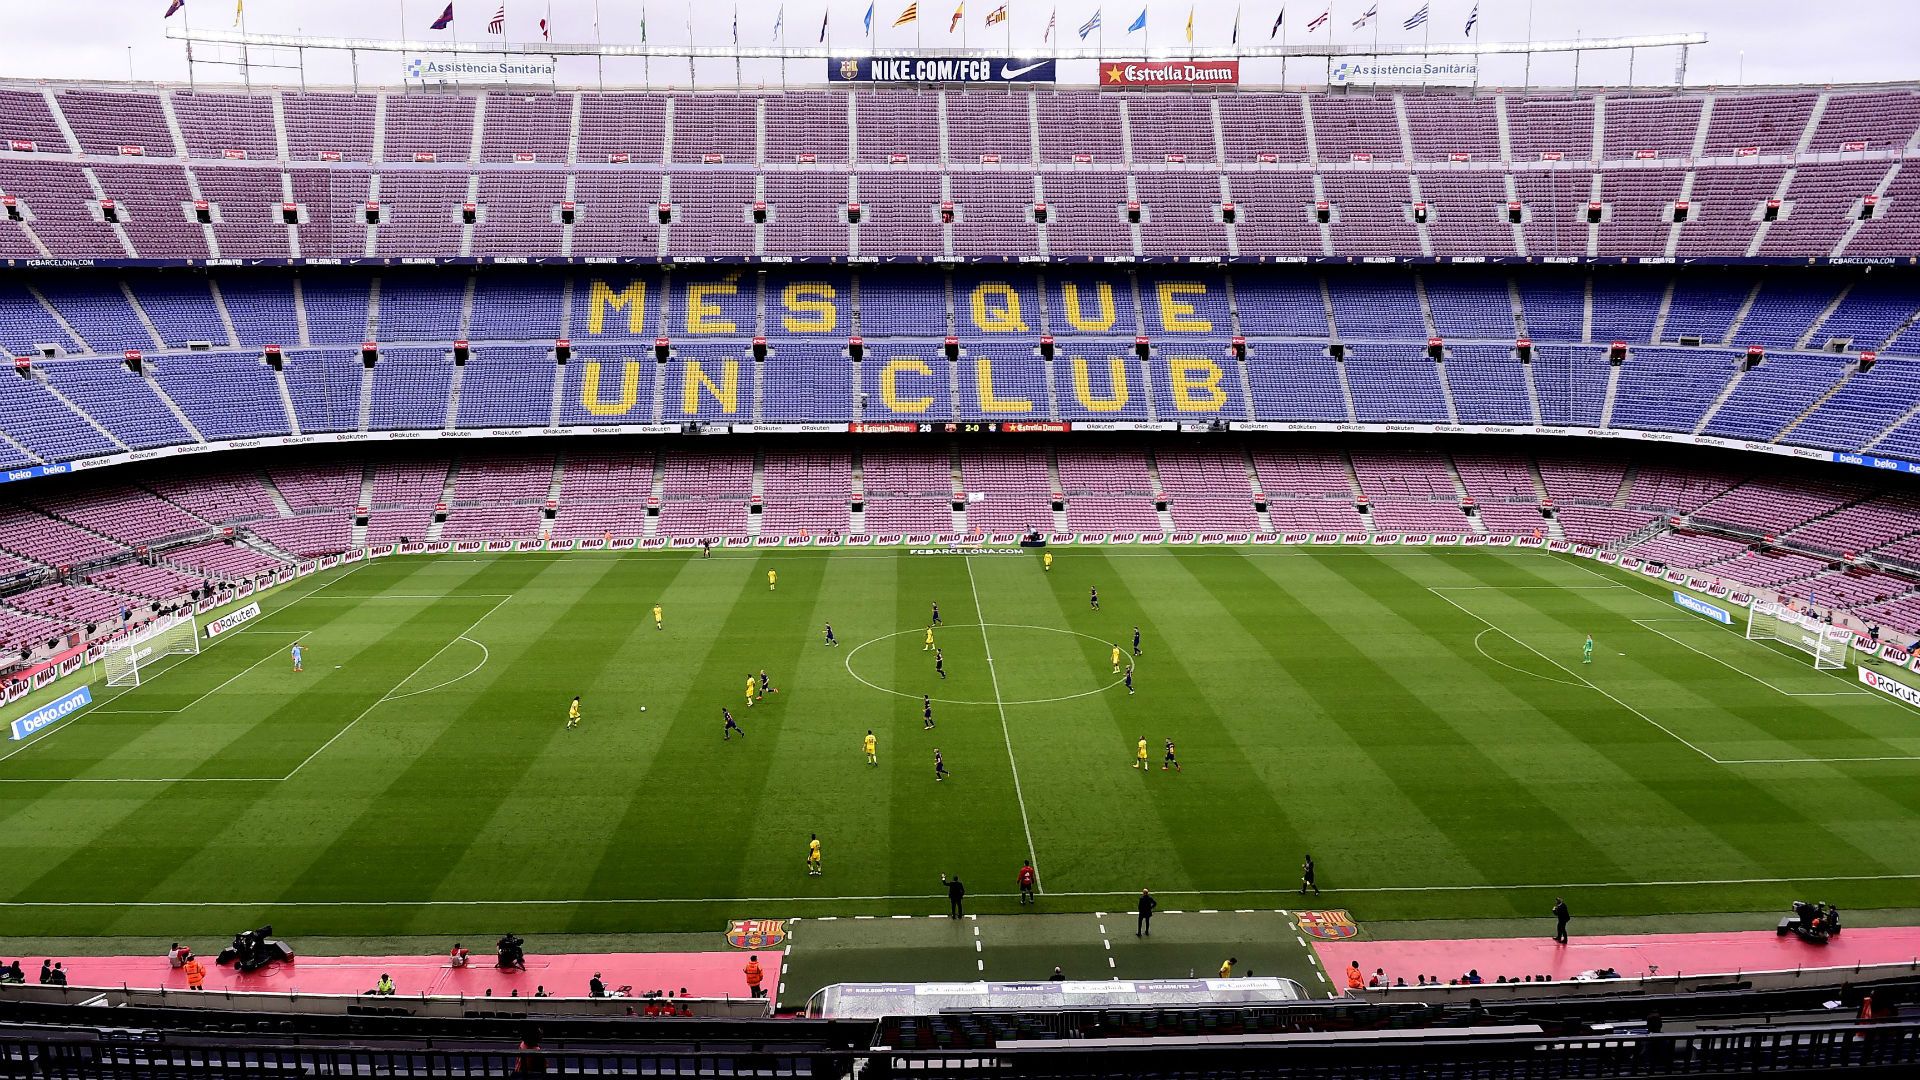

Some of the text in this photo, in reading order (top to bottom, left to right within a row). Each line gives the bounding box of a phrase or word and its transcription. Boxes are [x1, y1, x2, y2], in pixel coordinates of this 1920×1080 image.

[428, 60, 552, 74] Assistència Sanitària
[871, 60, 991, 81] NIKE.COM/FCB
[1353, 62, 1477, 76] Assistència Sanitària
[1124, 64, 1232, 82] Estrella Damm
[26, 259, 95, 267] FCBARCELONA.COM
[1829, 257, 1895, 265] FCBARCELONA.COM
[588, 268, 1213, 334] MÉS QUE
[581, 356, 1228, 416] UN CLUB
[919, 424, 980, 432] 26 2-0
[1245, 422, 1269, 430] Rakuten
[1341, 423, 1366, 431] Rakuten
[1390, 424, 1415, 432] Rakuten
[1440, 425, 1465, 433] Rakuten
[1489, 426, 1515, 434] Rakuten
[1541, 427, 1566, 435] Rakuten
[341, 433, 368, 441] Rakuten
[394, 431, 421, 439] Rakuten
[446, 430, 472, 438] Rakuten
[1594, 429, 1620, 437] Rakuten
[1647, 432, 1673, 441] Rakuten
[235, 440, 261, 448] Rakuten
[286, 435, 315, 444] Rakuten
[1700, 436, 1725, 446] Rakuten
[183, 444, 208, 454] Rakuten
[1749, 442, 1774, 452] Rakuten
[134, 451, 158, 460] Rakuten
[1798, 448, 1823, 459] Rakuten
[86, 458, 111, 467] Rakuten
[1840, 453, 1863, 465] beko
[1874, 458, 1898, 469] beko
[43, 463, 66, 475] beko
[9, 469, 32, 481] beko
[612, 537, 634, 547] MILO
[643, 537, 665, 547] MILO
[673, 536, 695, 546] MILO
[728, 536, 749, 546] MILO
[758, 536, 780, 546] MILO
[788, 535, 810, 545] MILO
[819, 535, 840, 545] MILO
[849, 534, 870, 544] MILO
[879, 533, 900, 544] MILO
[909, 533, 930, 543] MILO
[939, 533, 960, 543] MILO
[963, 533, 984, 543] MILO
[993, 533, 1014, 543] MILO
[1053, 533, 1074, 543] MILO
[1083, 533, 1104, 543] MILO
[1113, 532, 1133, 542] MILO
[1143, 532, 1163, 542] MILO
[1172, 532, 1193, 542] MILO
[1202, 533, 1223, 543] MILO
[1226, 533, 1248, 543] MILO
[1256, 533, 1277, 543] MILO
[1286, 533, 1307, 543] MILO
[1316, 533, 1337, 543] MILO
[1345, 533, 1367, 543] MILO
[1375, 533, 1397, 543] MILO
[1405, 533, 1427, 543] MILO
[1435, 534, 1457, 544] MILO
[1465, 534, 1486, 544] MILO
[1490, 535, 1511, 544] MILO
[1520, 536, 1542, 545] MILO
[401, 541, 424, 552] MILO
[427, 541, 449, 551] MILO
[458, 540, 480, 551] MILO
[489, 540, 511, 550] MILO
[520, 539, 542, 550] MILO
[551, 539, 573, 549] MILO
[582, 538, 603, 548] MILO
[1550, 540, 1569, 551] MILO
[345, 549, 363, 561] MILO
[371, 545, 392, 556] MILO
[910, 548, 1024, 556] FCBARCELONA.COM
[1576, 545, 1594, 555] MILO
[1600, 550, 1617, 560] MILO
[321, 556, 338, 567] MILO
[1622, 557, 1639, 567] MILO
[300, 561, 315, 573] MILO
[1645, 564, 1662, 575] MILO
[279, 567, 294, 582] MILO
[1668, 571, 1685, 581] MILO
[259, 575, 273, 589] MILO
[1690, 578, 1707, 589] MILO
[238, 583, 253, 598] MILO
[1709, 584, 1726, 595] MILO
[216, 590, 232, 605] MILO
[1731, 591, 1749, 604] MILO
[199, 597, 214, 611] MILO
[1677, 595, 1723, 621] beko.com
[178, 605, 193, 618] MILO
[221, 606, 257, 630] Rakuten
[1856, 636, 1877, 650] MILO
[1884, 647, 1907, 661] MILO
[63, 654, 81, 672] MILO
[37, 666, 56, 684] MILO
[9, 680, 29, 697] MILO
[1877, 676, 1920, 705] Rakut
[22, 693, 85, 732] beko.com
